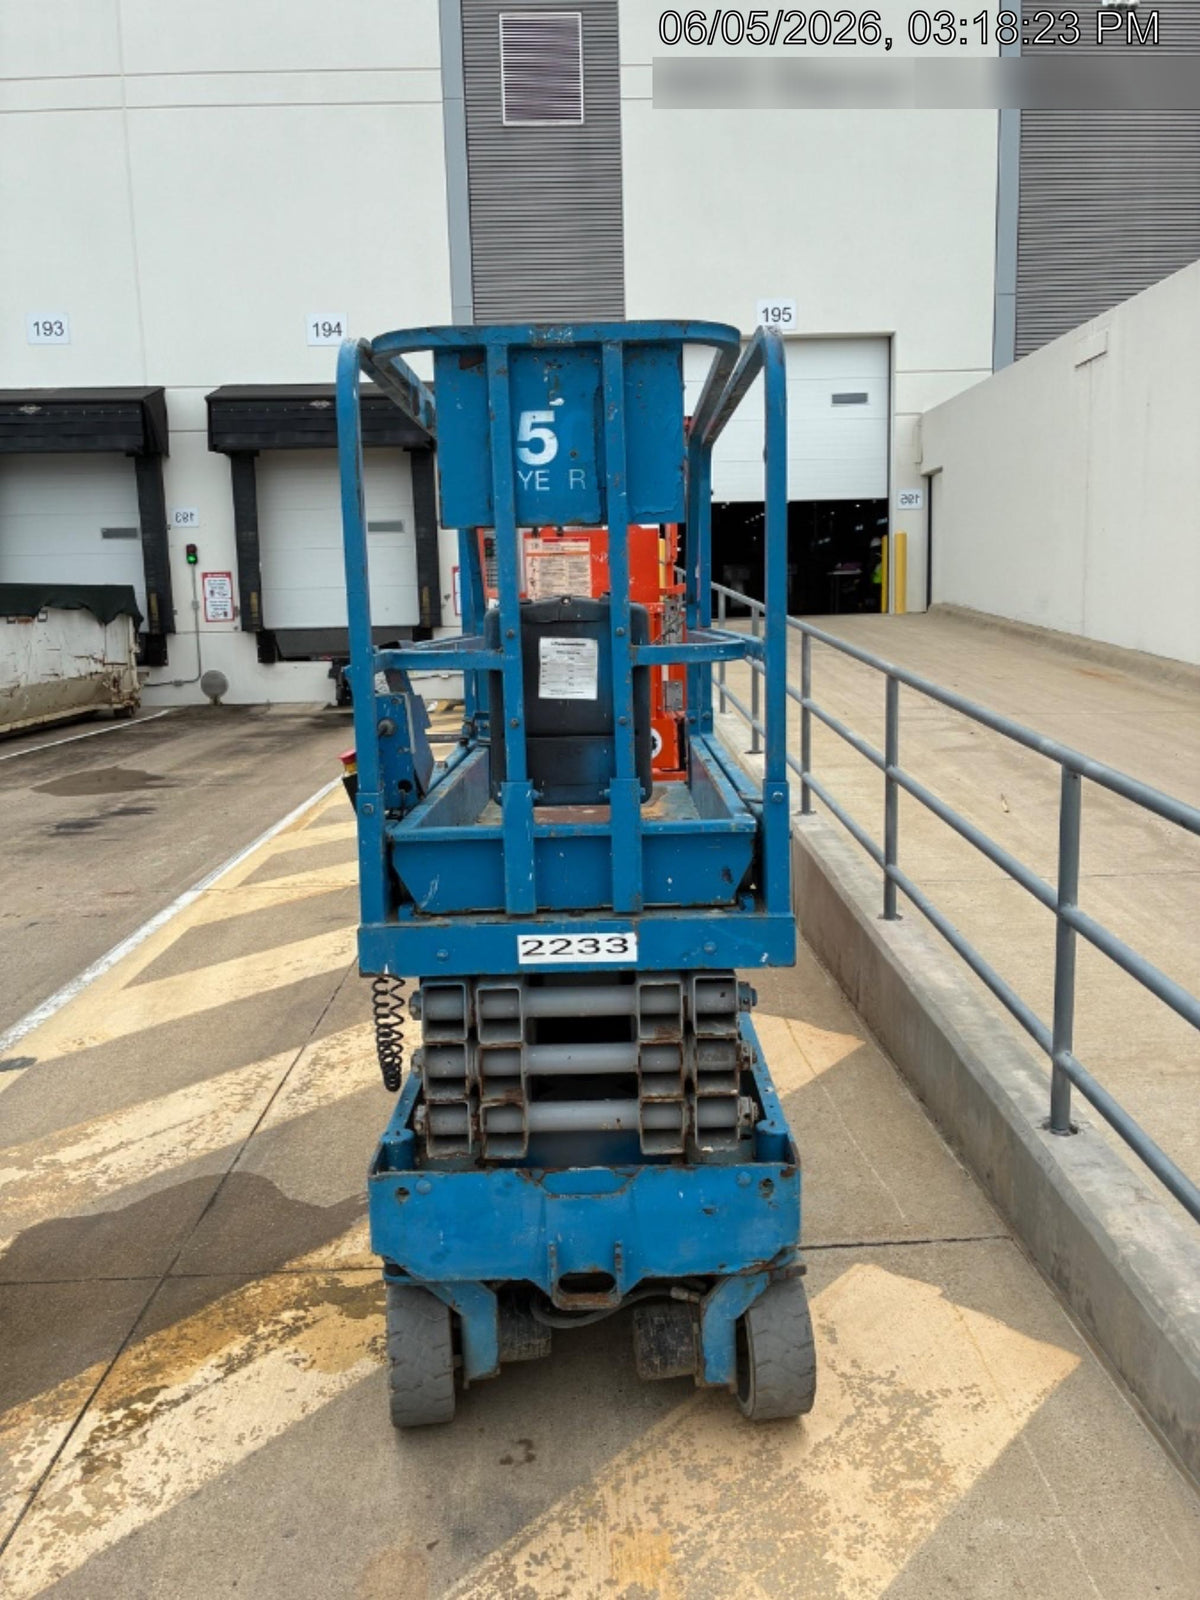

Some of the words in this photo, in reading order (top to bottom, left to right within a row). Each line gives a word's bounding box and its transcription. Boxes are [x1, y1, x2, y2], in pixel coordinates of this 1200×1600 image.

[762, 306, 792, 323] 195
[33, 320, 64, 337] 193
[312, 321, 342, 338] 194
[521, 937, 629, 957] 2233
